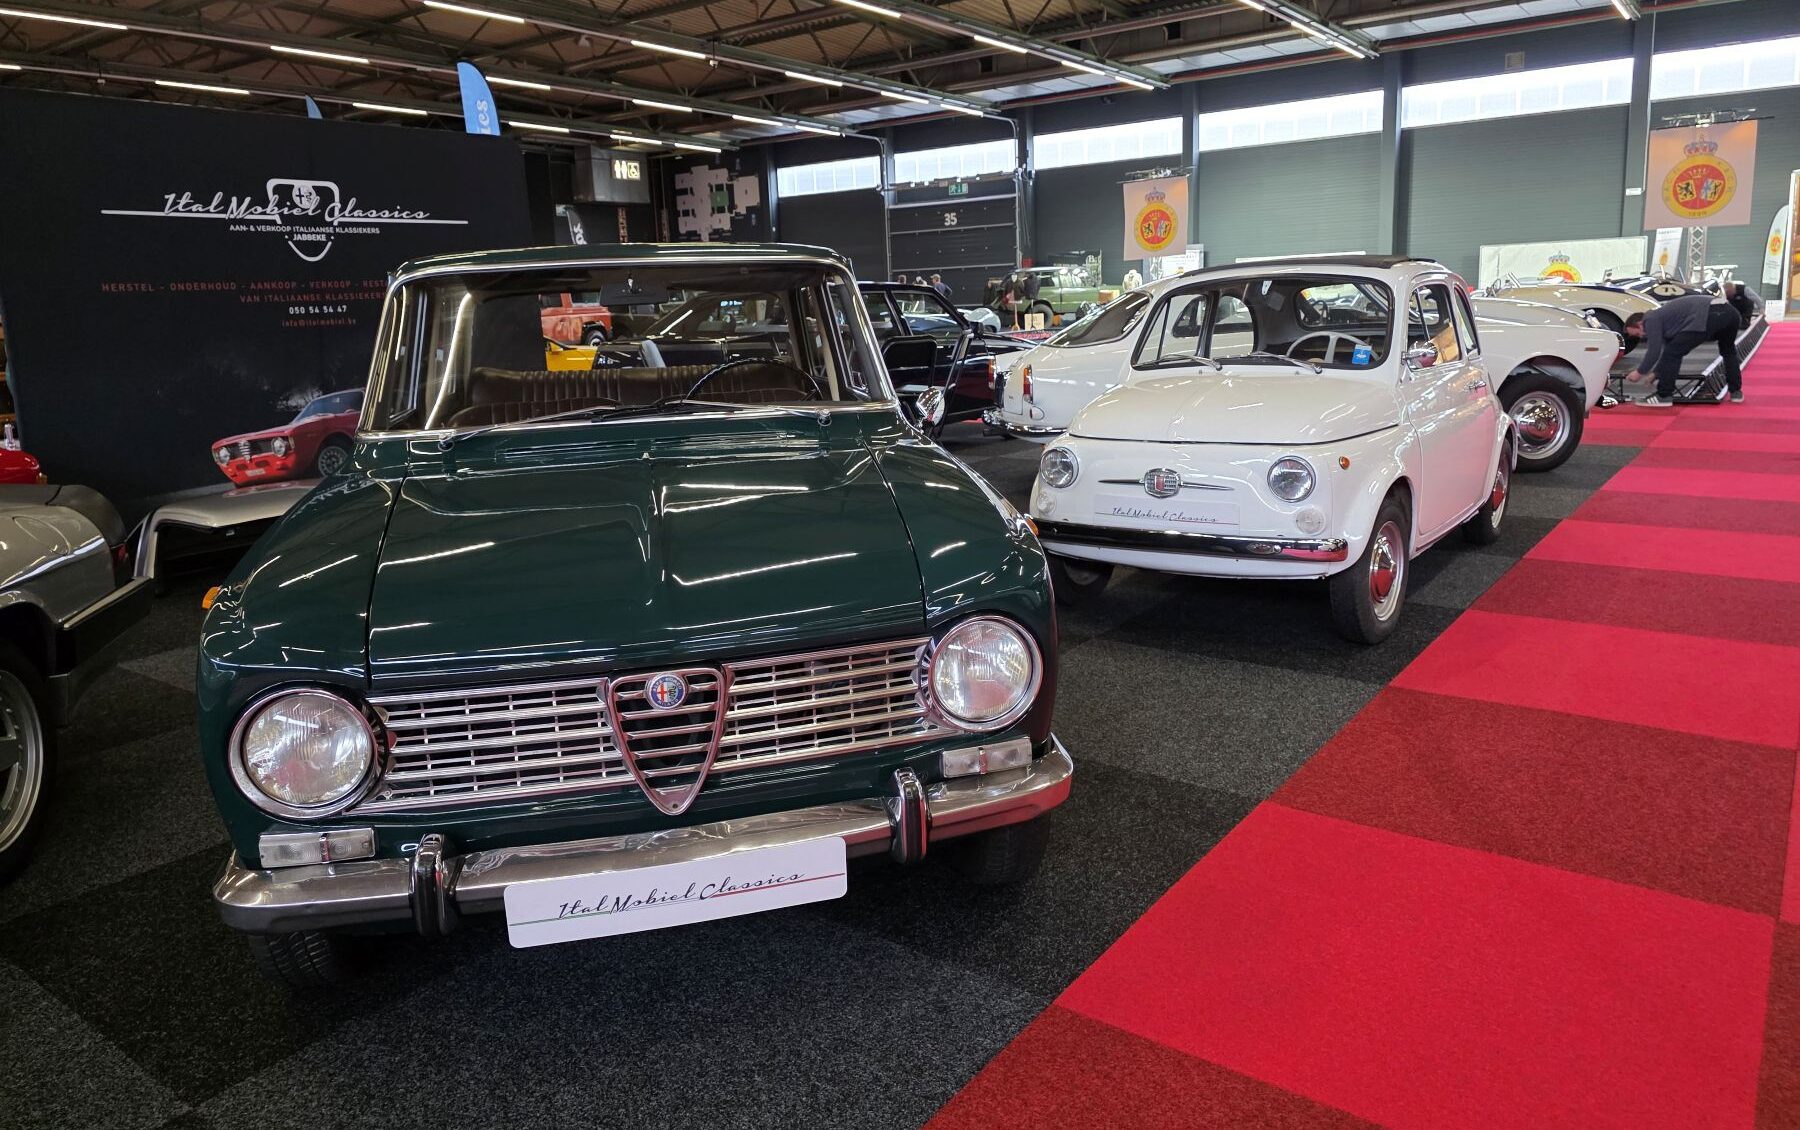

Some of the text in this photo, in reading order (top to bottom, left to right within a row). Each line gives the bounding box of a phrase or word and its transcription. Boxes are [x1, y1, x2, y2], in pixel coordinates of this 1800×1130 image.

[164, 191, 431, 222] Ital Mobiel Classics
[944, 212, 958, 226] 35
[292, 225, 335, 234] ITALIAANSE
[335, 226, 380, 234] KLASSIEKERS
[292, 233, 327, 242] JABBEKE
[101, 283, 155, 292] HERSTEL
[169, 282, 237, 291] ONDERHOUD
[250, 281, 297, 290] AANKOOP
[309, 280, 351, 289] VERKOOP
[240, 294, 260, 303] VAN
[264, 293, 321, 302] ITALIAANSE
[288, 304, 348, 315] 050 54 54 47
[1112, 507, 1217, 522] Ital Mobiel Classics
[556, 872, 806, 919] Ital Mobiel Classics
